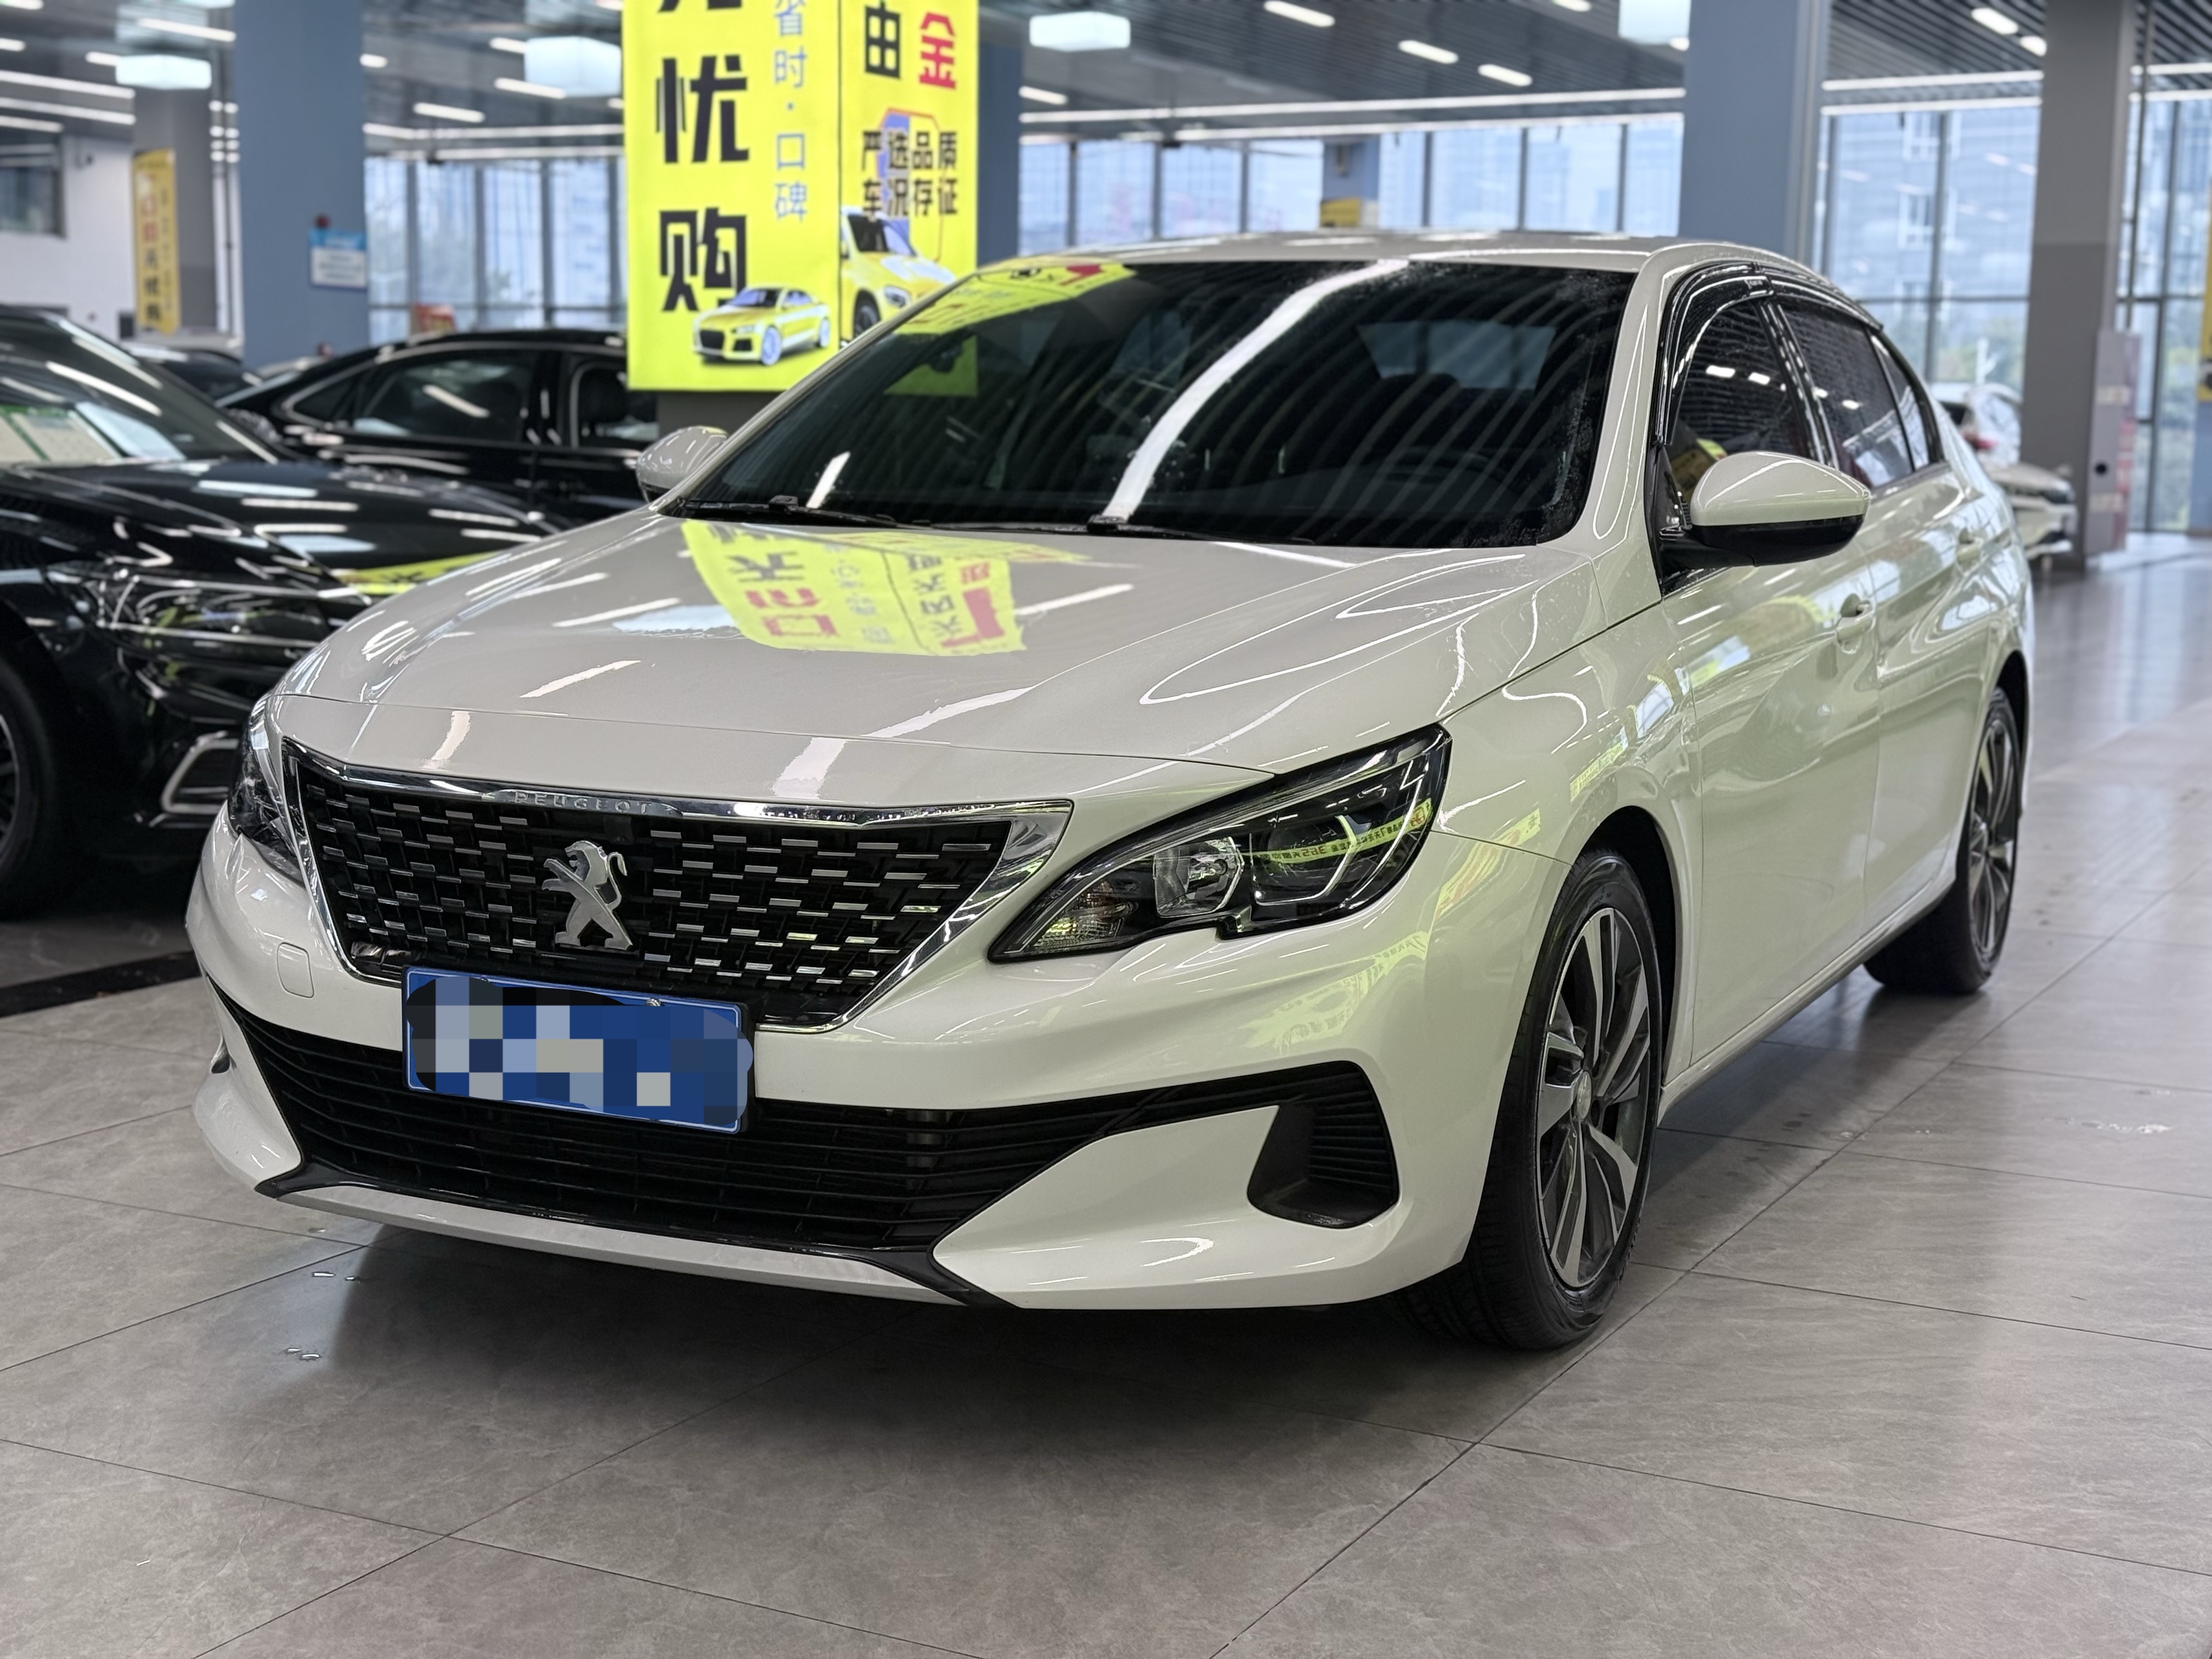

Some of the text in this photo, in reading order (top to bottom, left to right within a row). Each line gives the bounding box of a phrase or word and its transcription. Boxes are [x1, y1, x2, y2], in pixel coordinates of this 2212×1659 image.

[865, 1, 901, 80] 由
[919, 12, 956, 89] 金
[656, 0, 749, 312] 忧购
[862, 130, 957, 172] 严选品质
[862, 177, 958, 222] 车况存证
[515, 791, 652, 815] PEUGEOT
